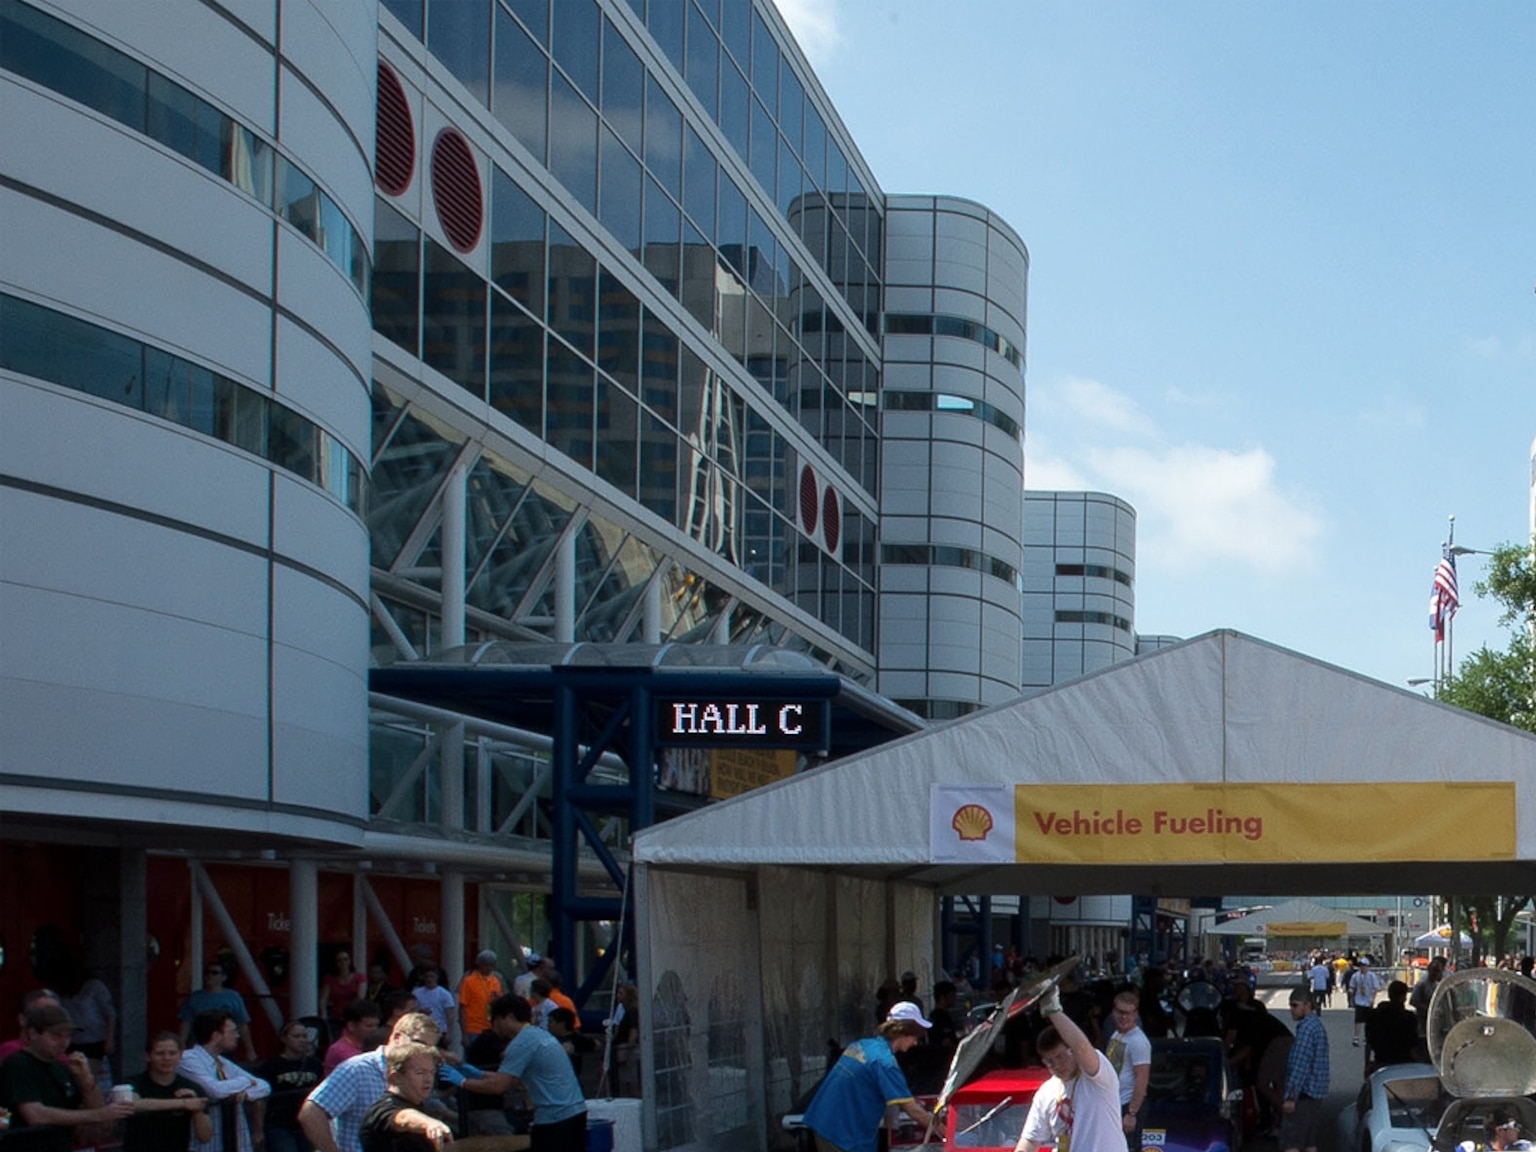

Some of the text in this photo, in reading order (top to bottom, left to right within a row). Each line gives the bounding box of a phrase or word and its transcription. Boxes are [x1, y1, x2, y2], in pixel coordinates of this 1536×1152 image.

[672, 703, 802, 734] HALL C
[1033, 808, 1263, 841] Vehicle Fueling
